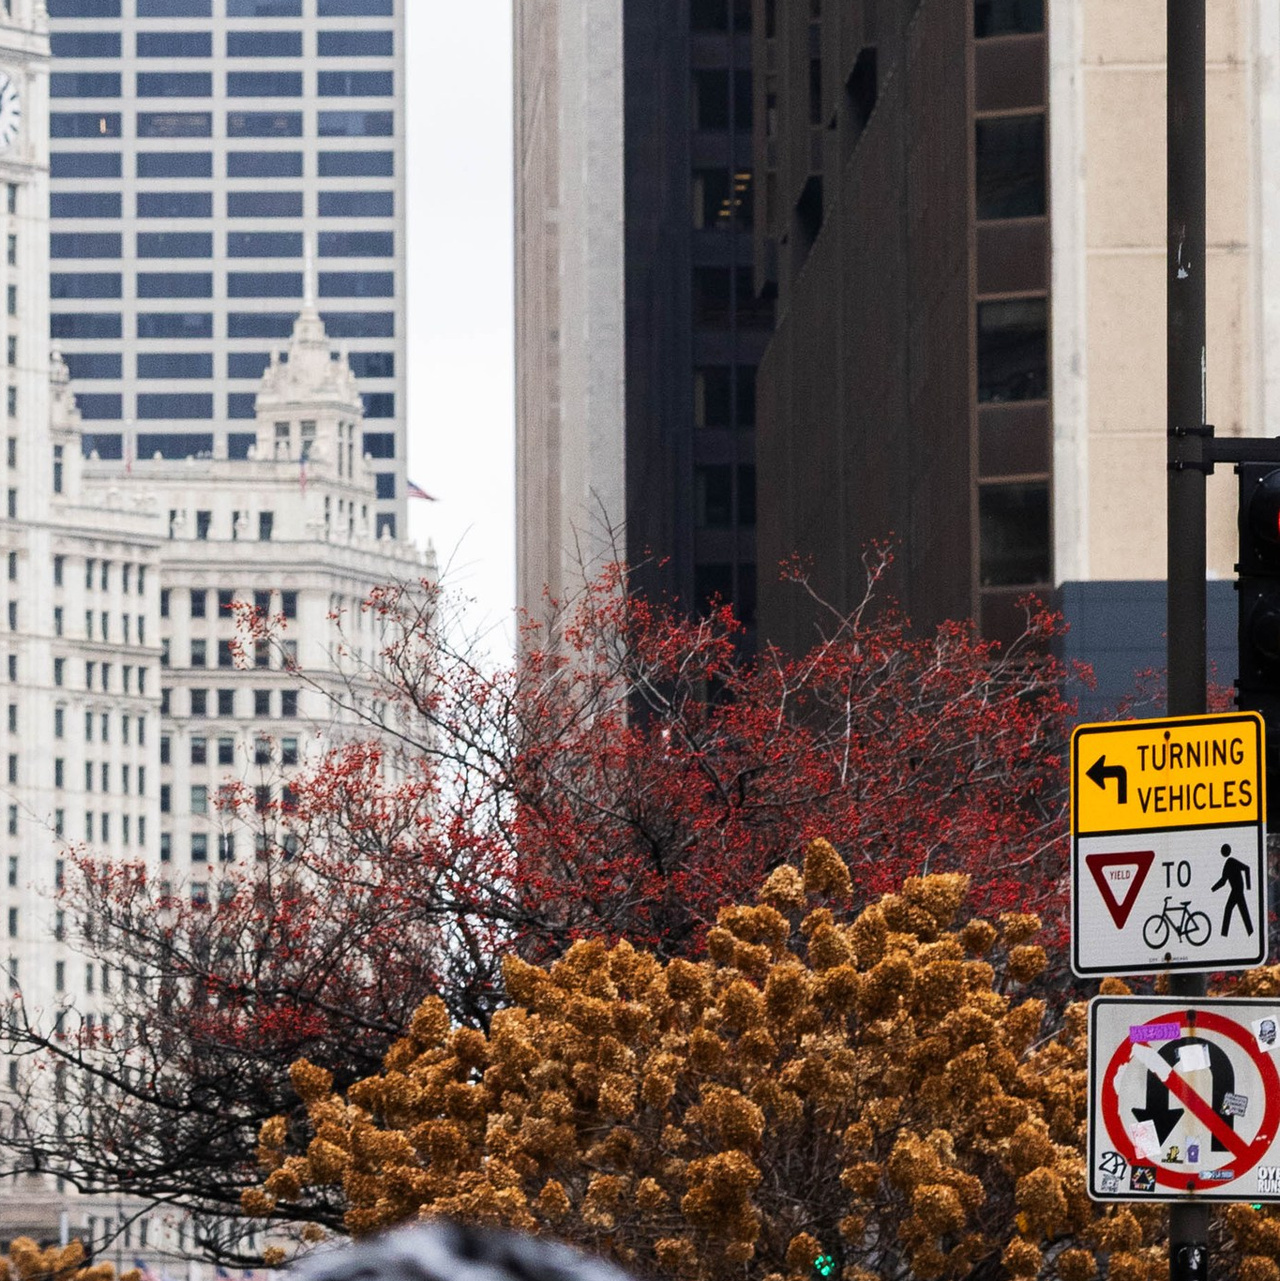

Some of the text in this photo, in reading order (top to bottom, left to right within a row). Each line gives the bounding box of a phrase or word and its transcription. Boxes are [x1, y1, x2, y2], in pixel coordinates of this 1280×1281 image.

[1136, 737, 1245, 772] TURNING
[1136, 779, 1253, 814] VEHICLES
[1109, 870, 1131, 881] YIELD
[1161, 860, 1192, 889] TO
